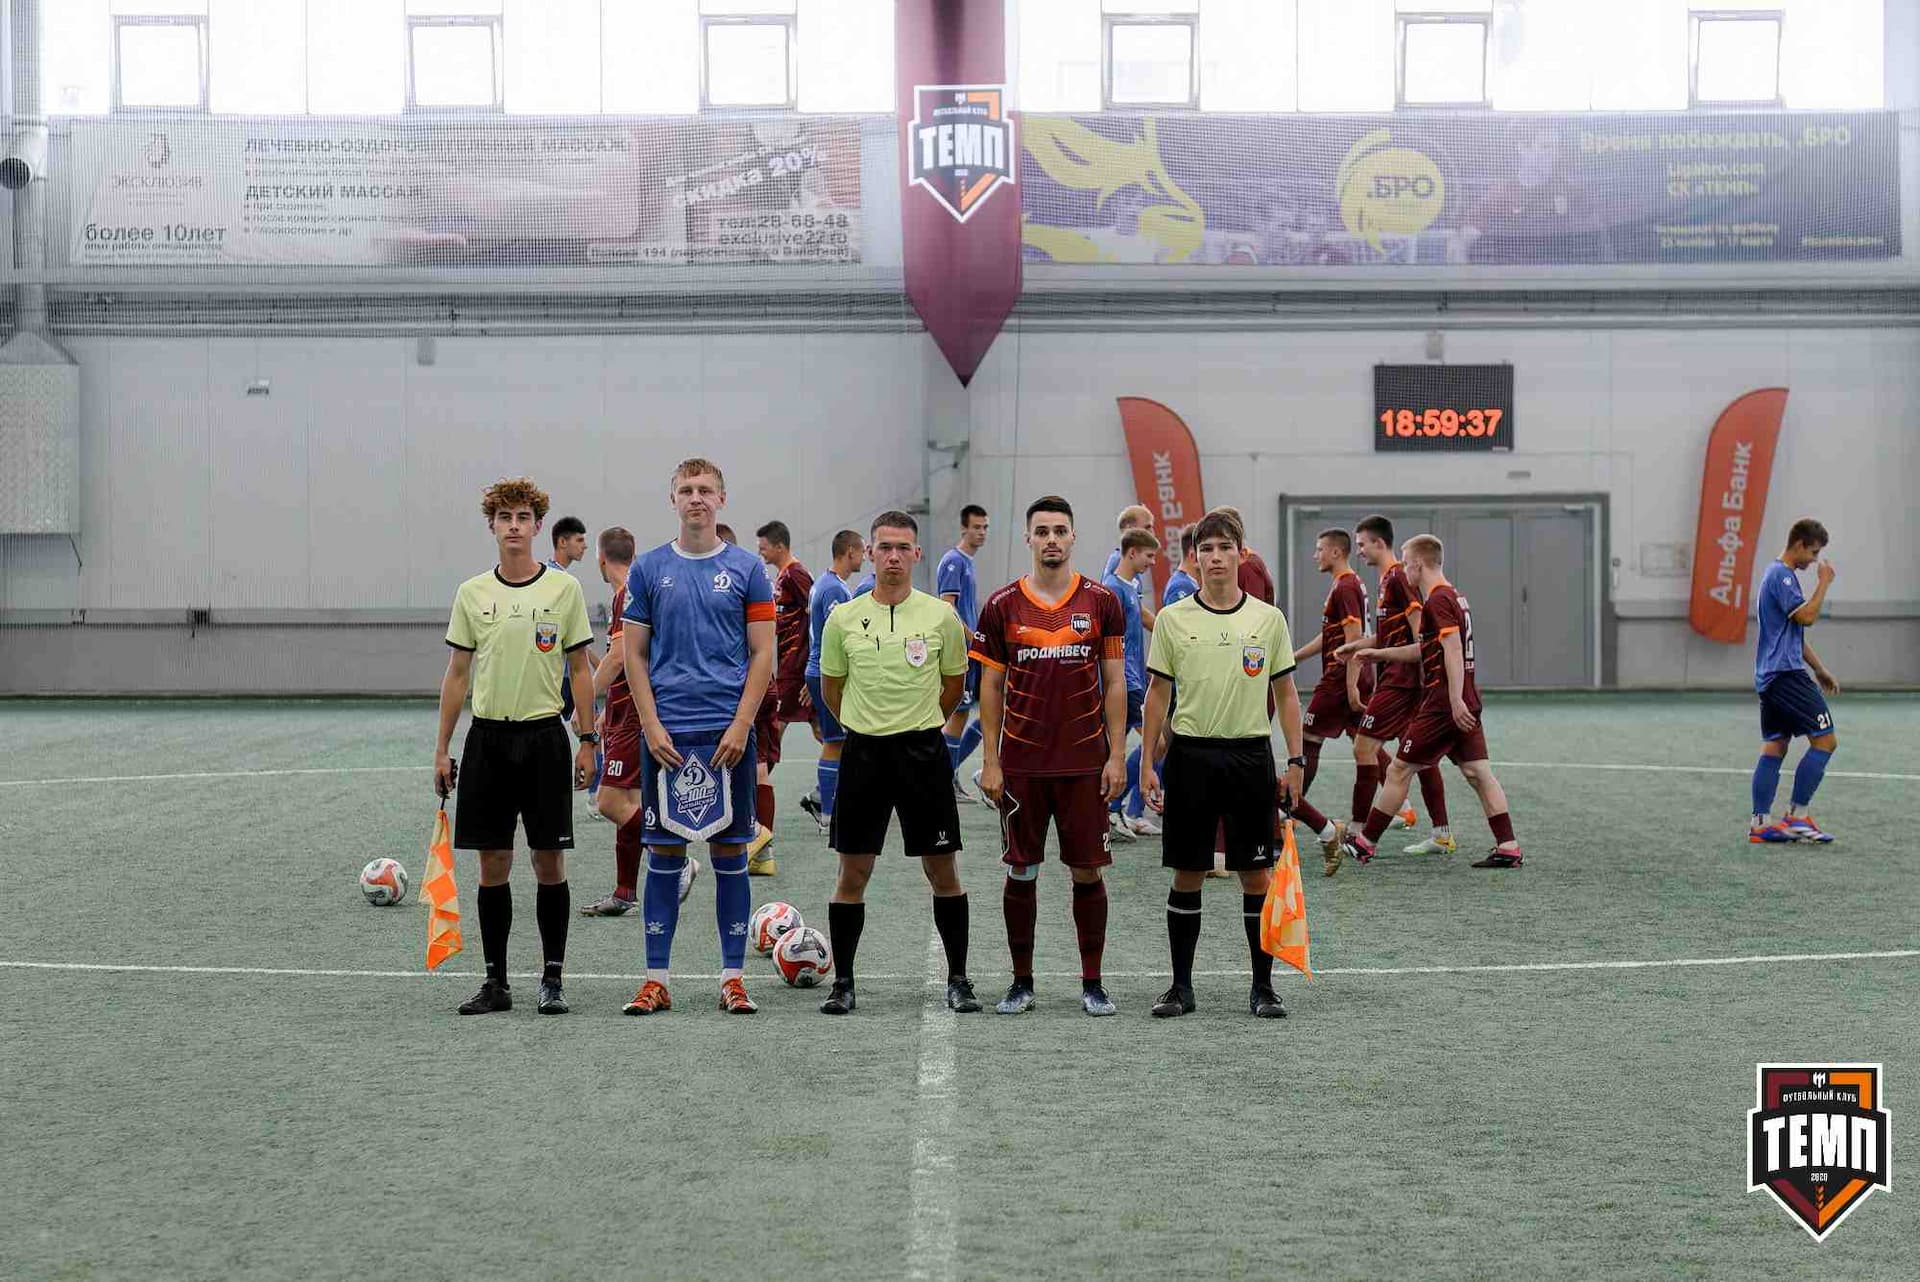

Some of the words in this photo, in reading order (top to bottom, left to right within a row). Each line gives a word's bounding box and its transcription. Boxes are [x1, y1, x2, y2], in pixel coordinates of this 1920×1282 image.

[919, 123, 1004, 170] ТЕМП
[767, 144, 828, 177] 20%
[245, 182, 334, 201] ДЕТСКИЙ
[84, 222, 155, 242] более
[163, 223, 228, 242] 10лет
[1380, 408, 1503, 437] 18:59:37
[1721, 438, 1754, 511] Банк
[1709, 515, 1744, 606] Альфа
[1017, 645, 1092, 664] ПРОДИНВЕСТ
[1816, 712, 1831, 730] 21
[1403, 739, 1413, 754] 2
[607, 759, 623, 777] 20
